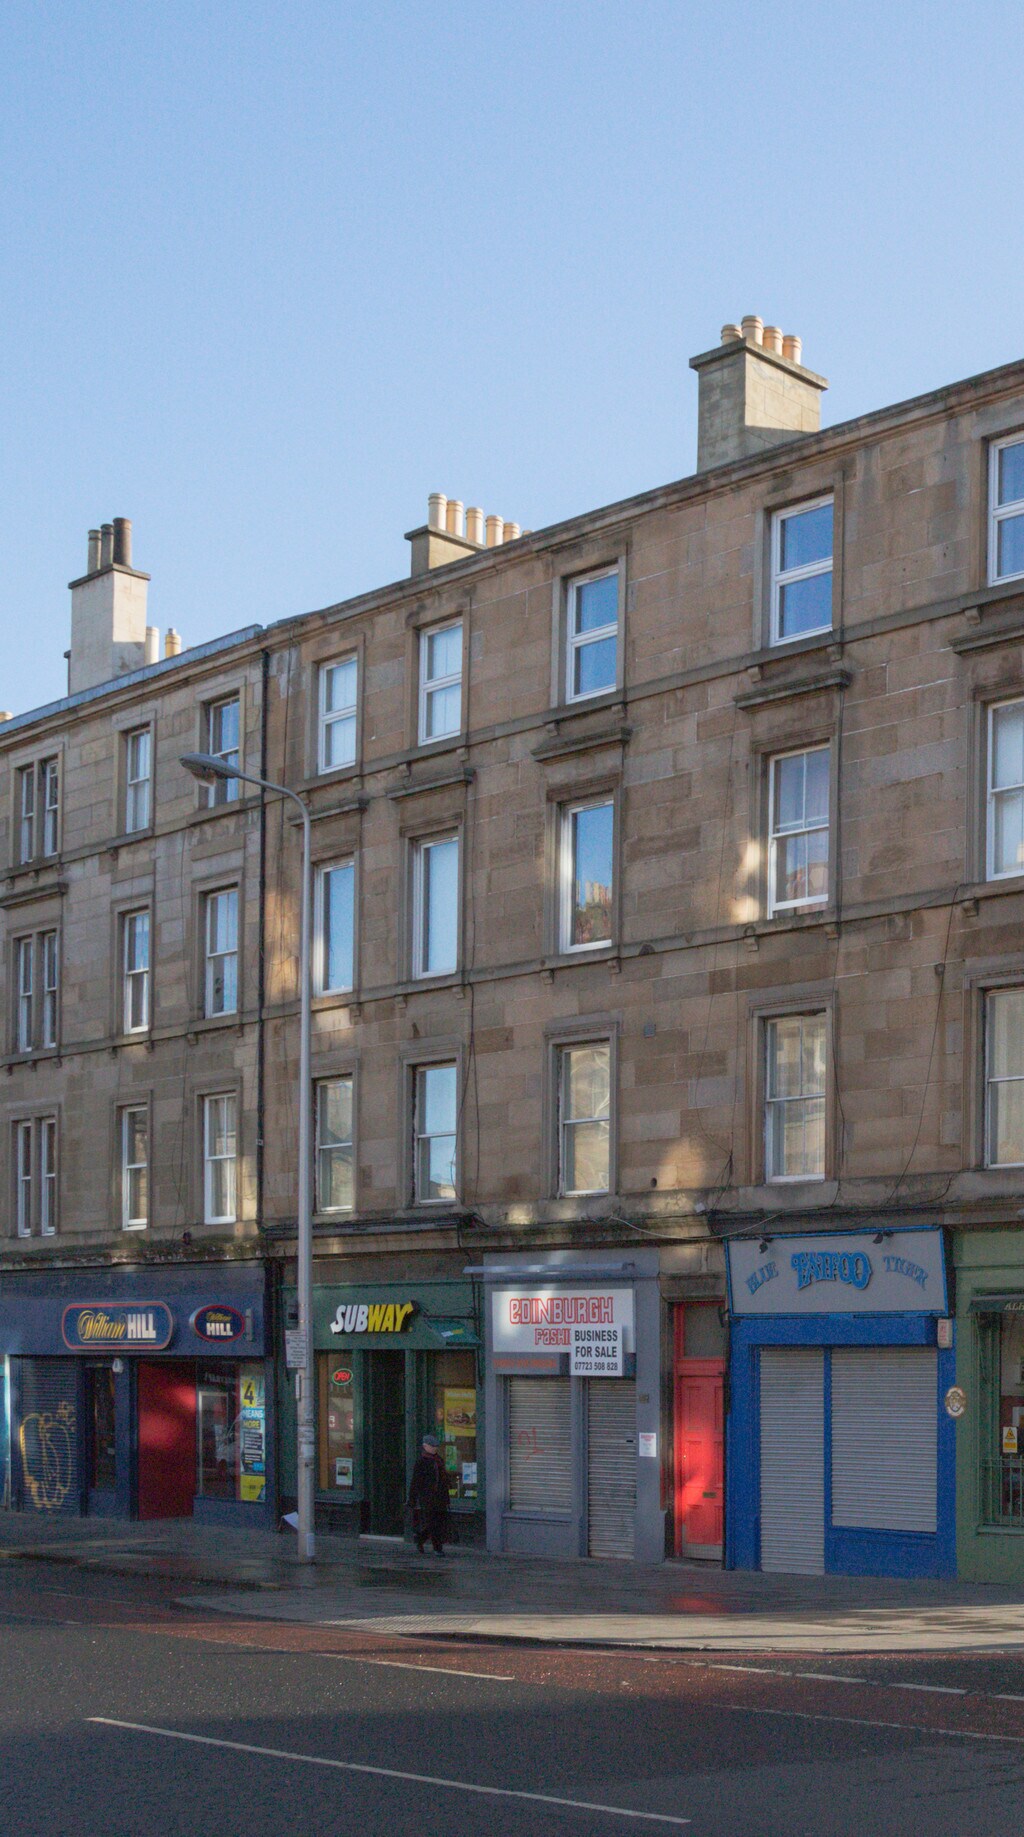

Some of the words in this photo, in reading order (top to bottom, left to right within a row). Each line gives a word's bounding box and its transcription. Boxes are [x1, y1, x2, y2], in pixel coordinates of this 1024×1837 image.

[744, 1261, 779, 1295] BLUE
[790, 1250, 874, 1290] TATTOO
[882, 1254, 928, 1291] TIGER
[78, 1309, 127, 1340] William
[127, 1313, 157, 1339] HILL
[330, 1301, 414, 1335] SUBWAY
[206, 1322, 233, 1336] HILL
[574, 1329, 618, 1342] BUSINESS
[575, 1347, 592, 1358] FOR
[594, 1346, 618, 1358] SALE
[574, 1362, 593, 1371] 07723
[334, 1370, 351, 1382] OPEN
[243, 1381, 255, 1406] 4
